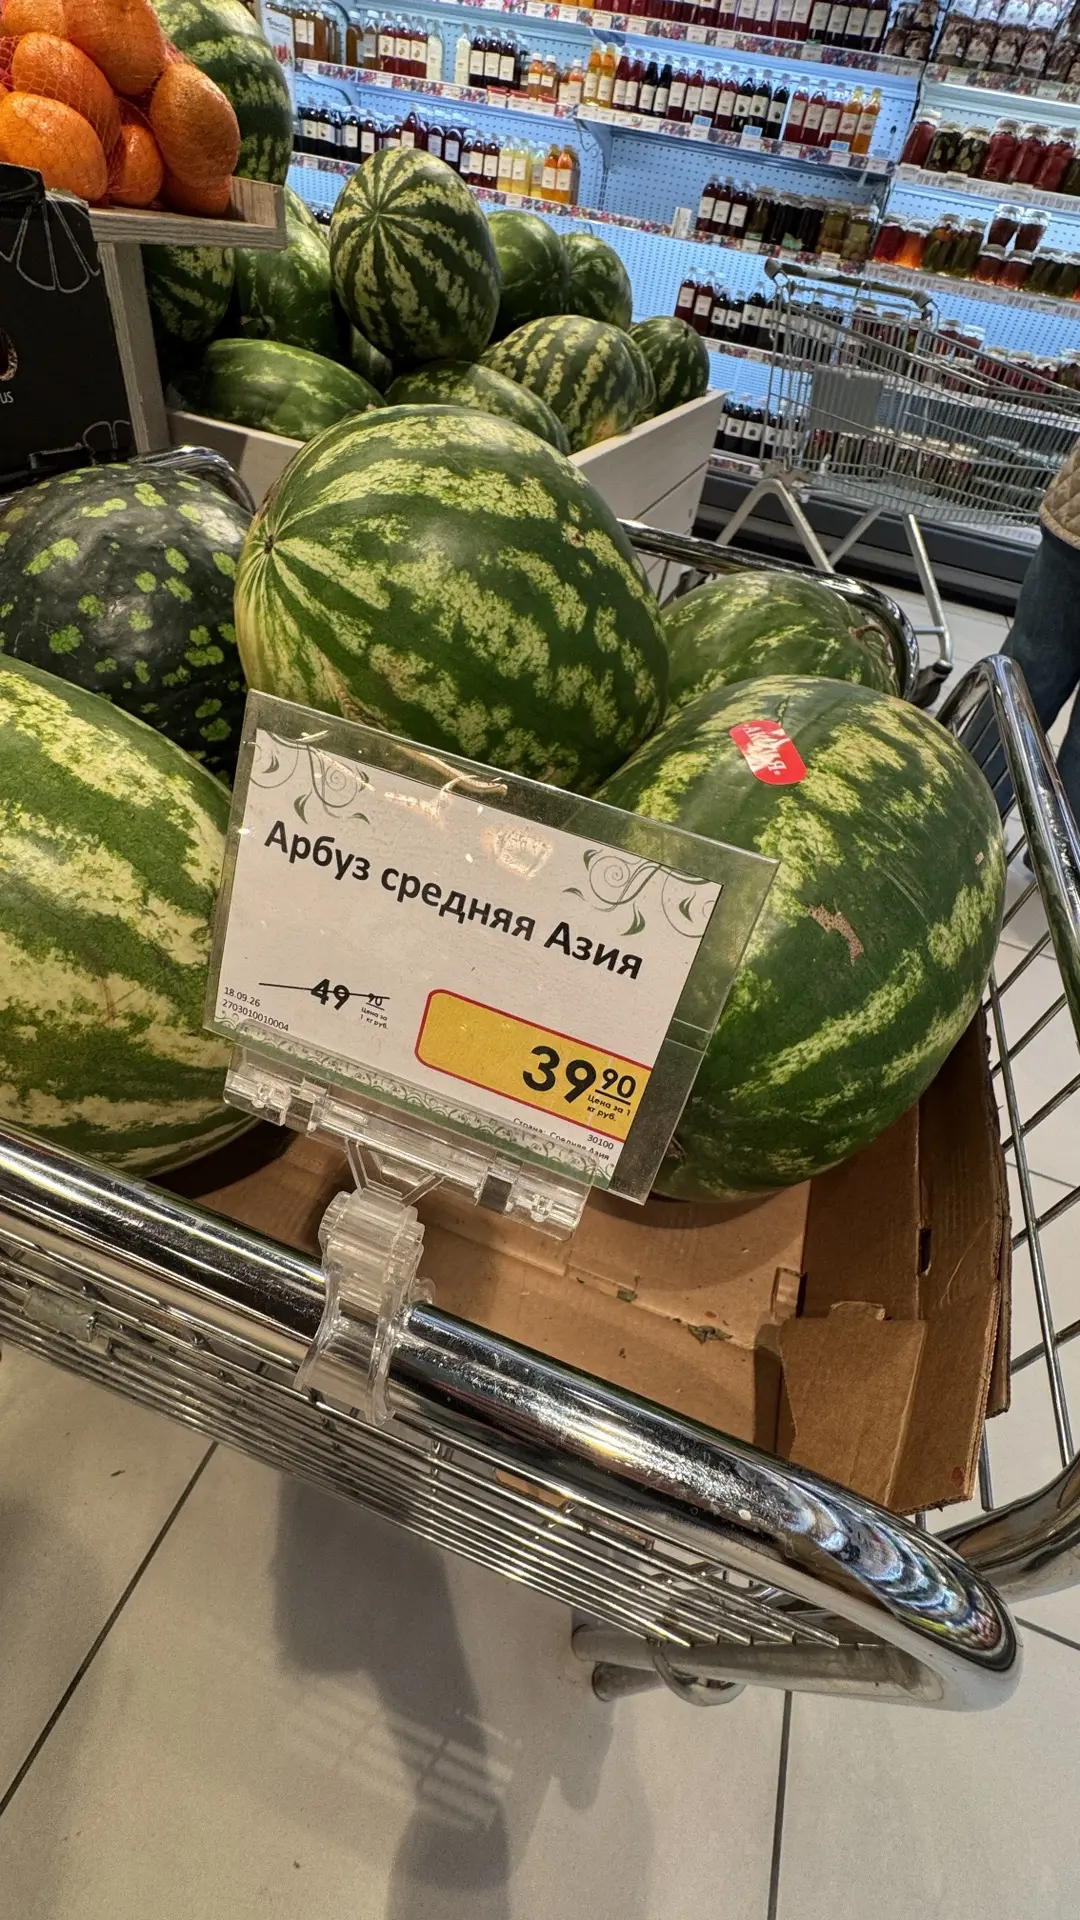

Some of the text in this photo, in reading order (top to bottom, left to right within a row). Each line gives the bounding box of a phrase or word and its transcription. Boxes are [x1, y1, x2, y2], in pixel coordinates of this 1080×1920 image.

[264, 820, 643, 980] Арбуз средняя Азия
[224, 986, 261, 1008] 18.09.26
[222, 998, 290, 1032] 2703010010004
[361, 1006, 380, 1018] Цена
[373, 1020, 389, 1030] руб.
[522, 1045, 637, 1104] 39 90
[586, 1106, 617, 1122] кг руб.
[587, 1094, 612, 1109] Цена
[613, 1104, 624, 1114] за
[587, 1134, 615, 1151] 30100
